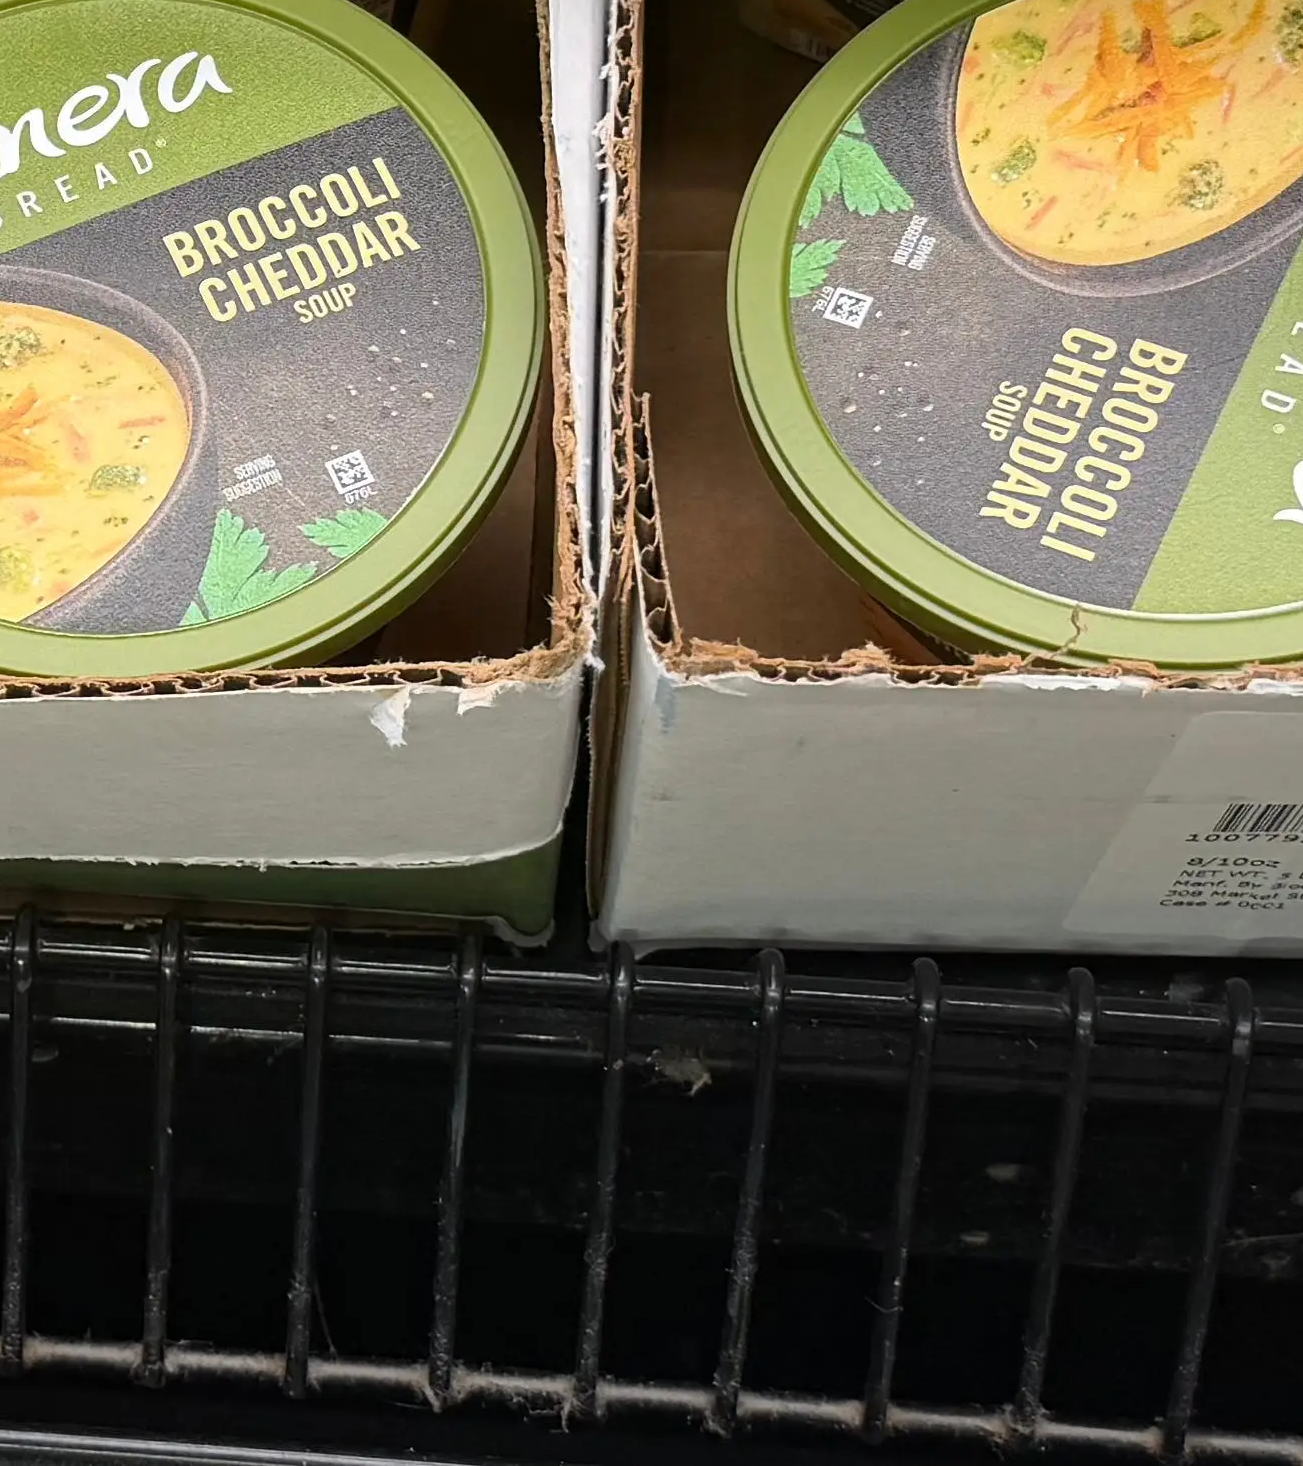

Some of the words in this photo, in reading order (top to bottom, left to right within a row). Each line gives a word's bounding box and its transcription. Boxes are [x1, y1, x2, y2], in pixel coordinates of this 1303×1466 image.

[161, 157, 402, 279] BROCCOLI
[892, 215, 929, 266] SUGGESTION
[196, 211, 421, 324] CHEDDAR
[908, 236, 937, 271] SERVING
[294, 281, 357, 325] SOUP
[811, 286, 835, 313] 676L
[978, 326, 1118, 531] CHEDDAR
[985, 380, 1022, 444] SOUP
[234, 454, 275, 482] SERVING
[1040, 338, 1189, 563] BROCCOLI
[222, 468, 282, 503] SUGGESTION
[1179, 870, 1224, 879] NET
